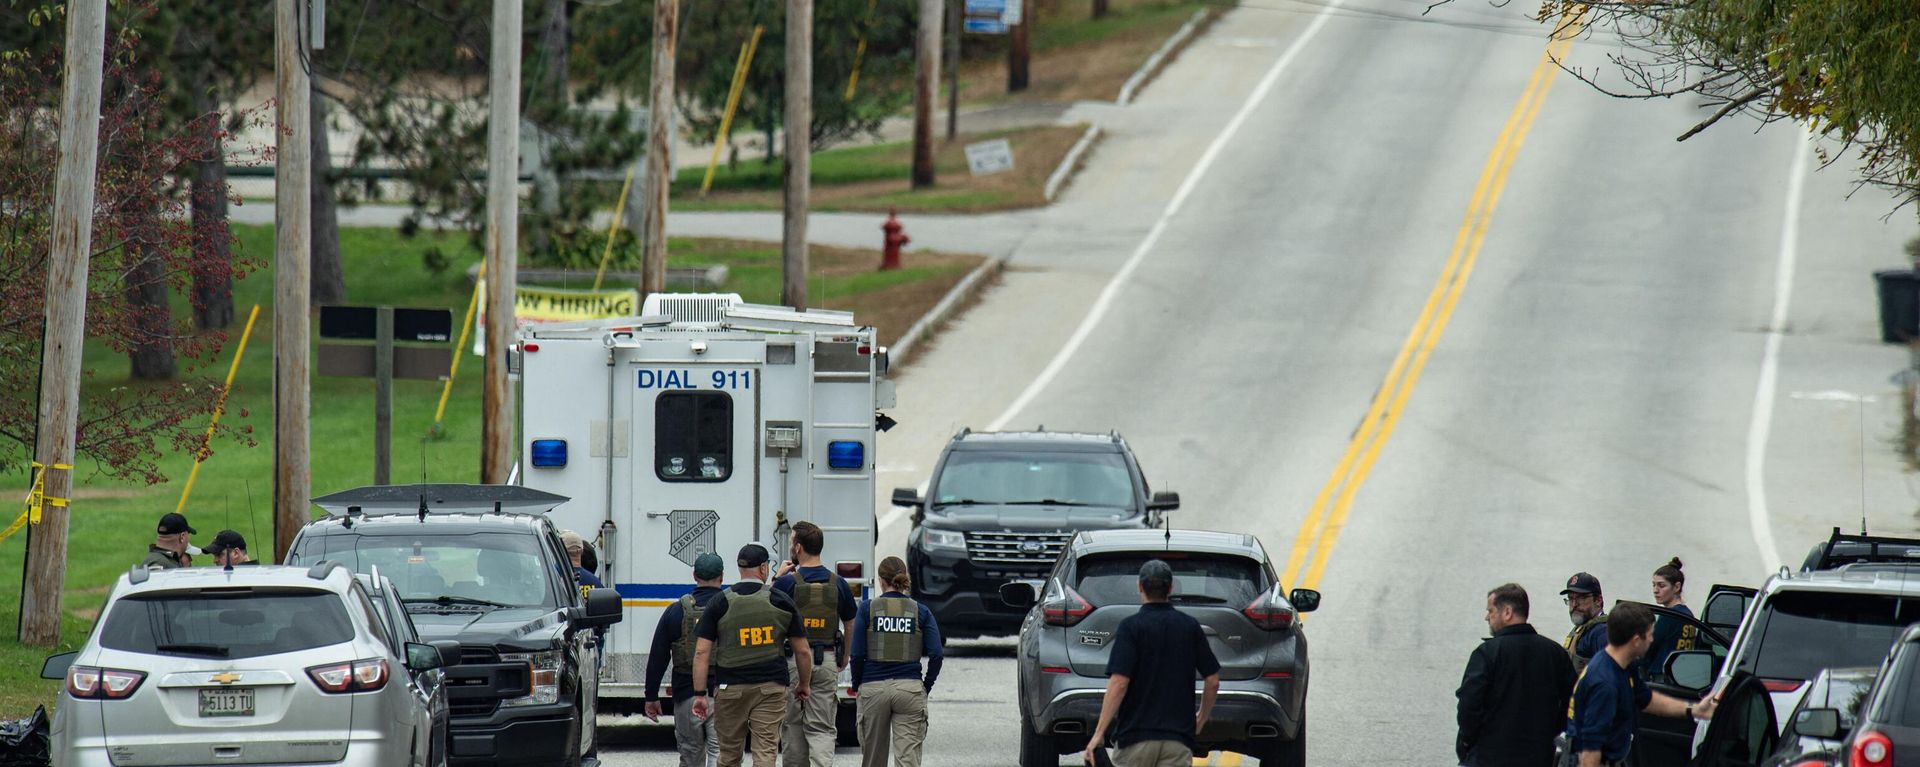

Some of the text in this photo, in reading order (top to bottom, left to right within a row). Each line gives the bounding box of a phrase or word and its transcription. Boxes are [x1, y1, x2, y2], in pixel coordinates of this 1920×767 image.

[550, 295, 631, 316] HIRING
[638, 370, 750, 389] DIAL 911
[672, 513, 717, 552] LEWISTON
[803, 618, 826, 628] FBI
[877, 617, 912, 632] POLICE
[739, 626, 774, 646] FBI
[239, 695, 253, 710] TU
